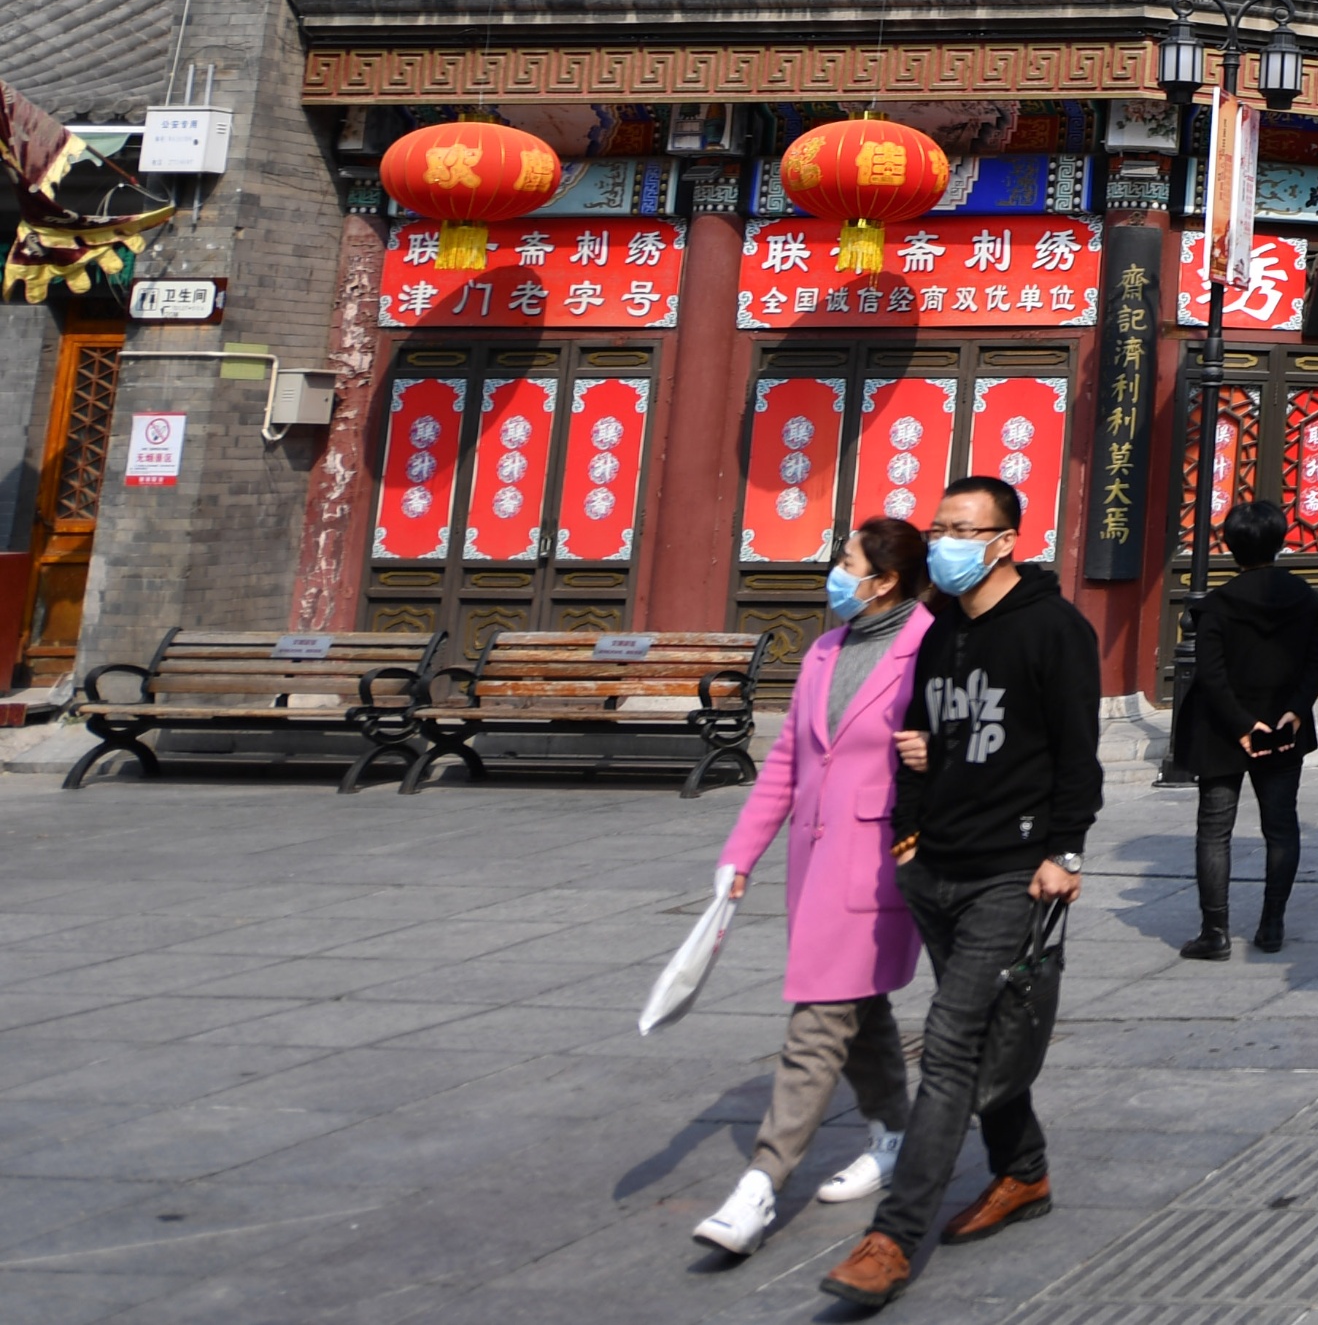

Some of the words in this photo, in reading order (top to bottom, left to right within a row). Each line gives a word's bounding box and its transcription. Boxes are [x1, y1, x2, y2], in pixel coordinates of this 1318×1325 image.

[403, 229, 667, 268] 联斋刺绣
[162, 288, 208, 304] 卫生间
[398, 279, 662, 317] 津门老字号
[759, 284, 1077, 315] 全国诚信经商双优单位
